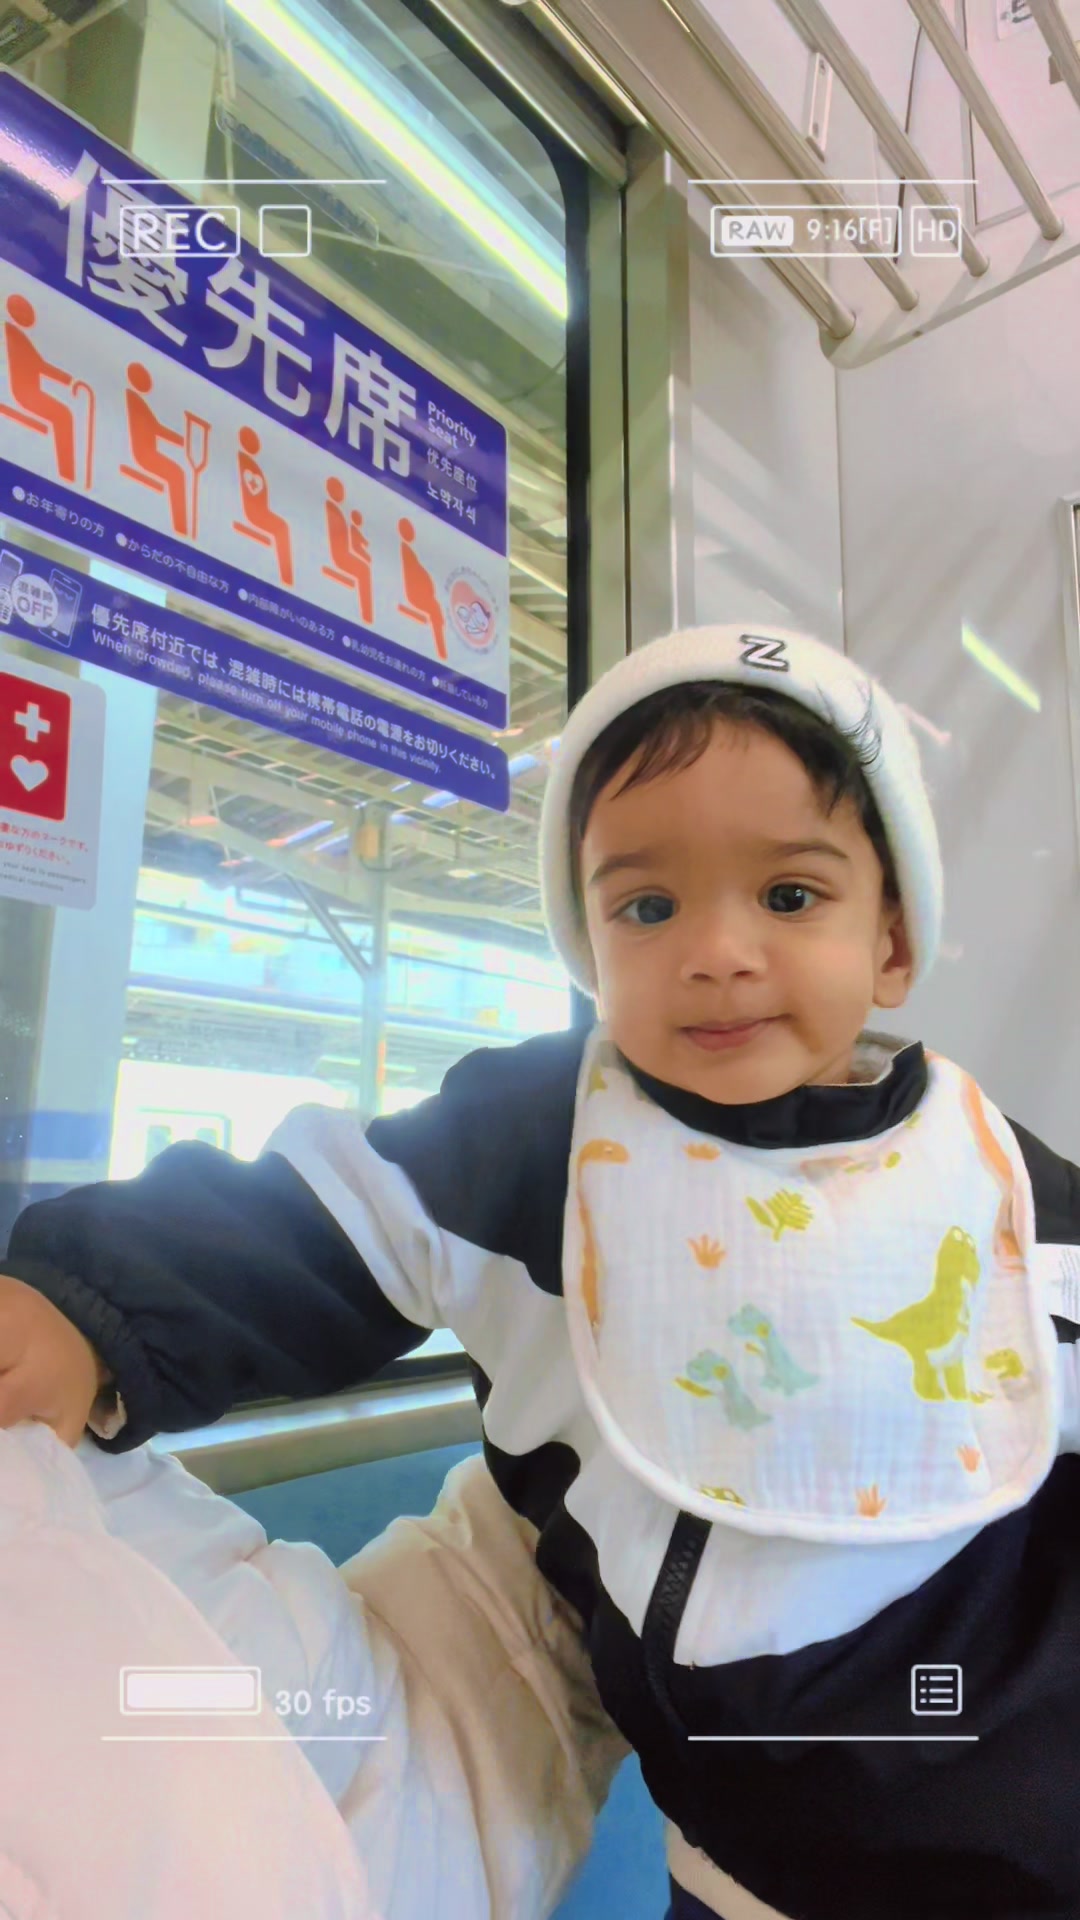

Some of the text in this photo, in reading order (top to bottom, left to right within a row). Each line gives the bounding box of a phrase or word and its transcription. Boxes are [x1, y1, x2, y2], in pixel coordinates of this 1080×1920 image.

[65, 149, 417, 478] 優先席
[427, 400, 477, 448] Priority
[428, 418, 459, 449] Seat
[427, 481, 476, 525] 노약자석
[17, 596, 53, 621] OFF
[91, 628, 132, 656] When
[284, 704, 308, 721] your
[310, 714, 344, 737] mobile
[347, 728, 377, 748] phone
[379, 741, 389, 753] in
[391, 743, 407, 760] this
